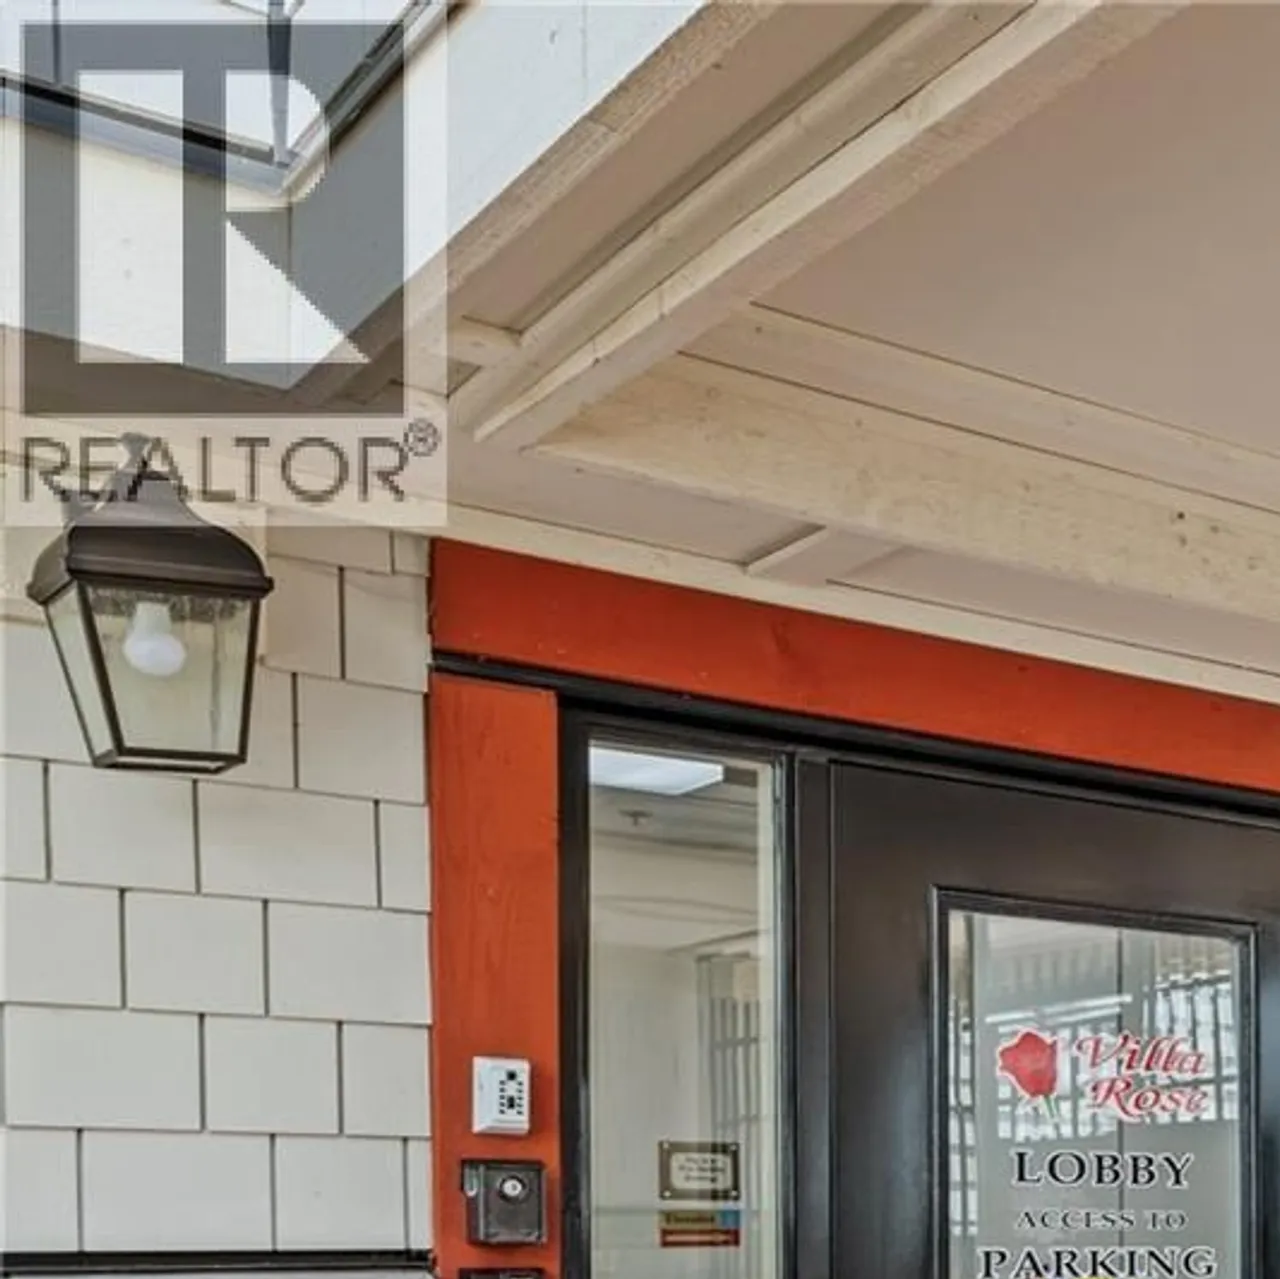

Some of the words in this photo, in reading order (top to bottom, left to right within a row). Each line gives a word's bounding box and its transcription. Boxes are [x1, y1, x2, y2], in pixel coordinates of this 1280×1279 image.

[1076, 1030, 1206, 1076] Villa
[1087, 1076, 1210, 1121] Rose
[1012, 1150, 1194, 1188] LOBBY
[1016, 1209, 1136, 1231] ACCESS
[1145, 1210, 1188, 1231] TO
